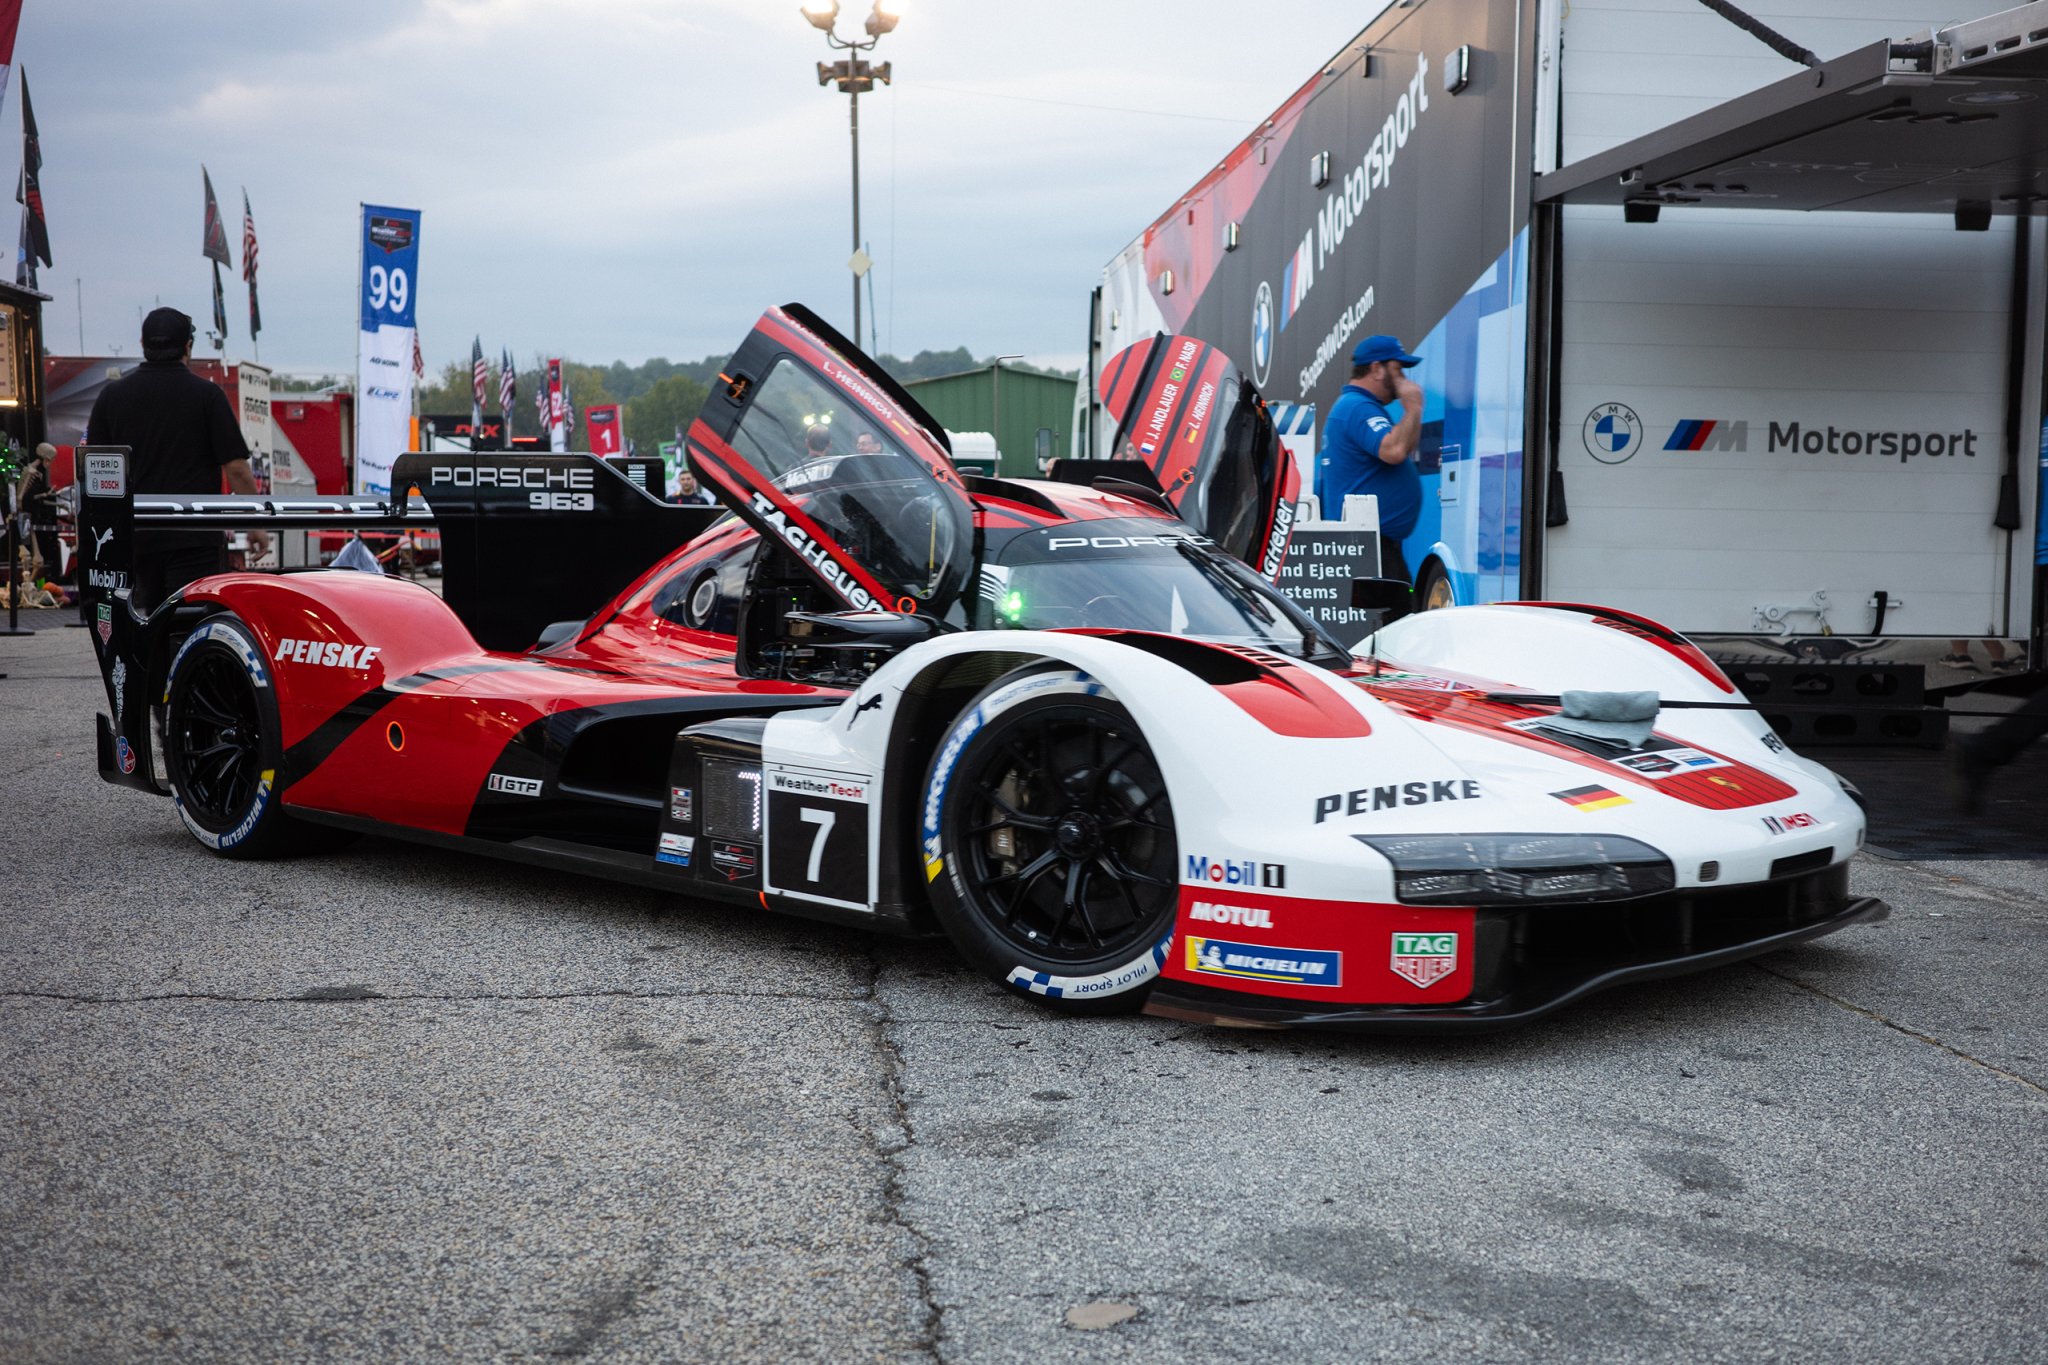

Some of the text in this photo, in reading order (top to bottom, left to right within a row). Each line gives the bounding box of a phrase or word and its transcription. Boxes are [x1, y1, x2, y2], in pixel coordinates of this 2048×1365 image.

[1318, 51, 1429, 271] Motorsport
[368, 264, 408, 314] 99
[1174, 340, 1198, 370] F. NASR
[1299, 285, 1375, 399] ShopBMWUSA.com
[822, 361, 893, 419] L. HEINRICH
[1146, 383, 1179, 441] J. ANDLAUER
[1187, 381, 1215, 430] L. HEINRICH
[600, 429, 612, 450] 1
[1590, 404, 1636, 423] BMW
[1767, 421, 1978, 463] Motorsport
[90, 459, 119, 469] HYBRID
[431, 467, 594, 489] PORSCHE
[100, 480, 119, 490] BOSCH
[529, 492, 594, 511] 963
[1312, 541, 1365, 556] Driver
[89, 568, 116, 589] Mobil
[1309, 564, 1352, 580] Eject
[1321, 606, 1367, 624] Right
[273, 637, 383, 671] PENSKE
[505, 779, 538, 793] GTP
[774, 775, 864, 799] WeatherTech
[737, 771, 762, 831] 7
[1313, 779, 1482, 825] PENSKE
[221, 797, 264, 848] MICHELIN
[800, 806, 837, 883] 7
[1187, 855, 1256, 886] Mobil
[1189, 901, 1274, 929] MOTUL
[1399, 936, 1453, 954] TAG
[1224, 953, 1328, 975] MICHELIN
[1393, 956, 1453, 984] HEUER
[1074, 964, 1148, 993] PILOT SPORT
